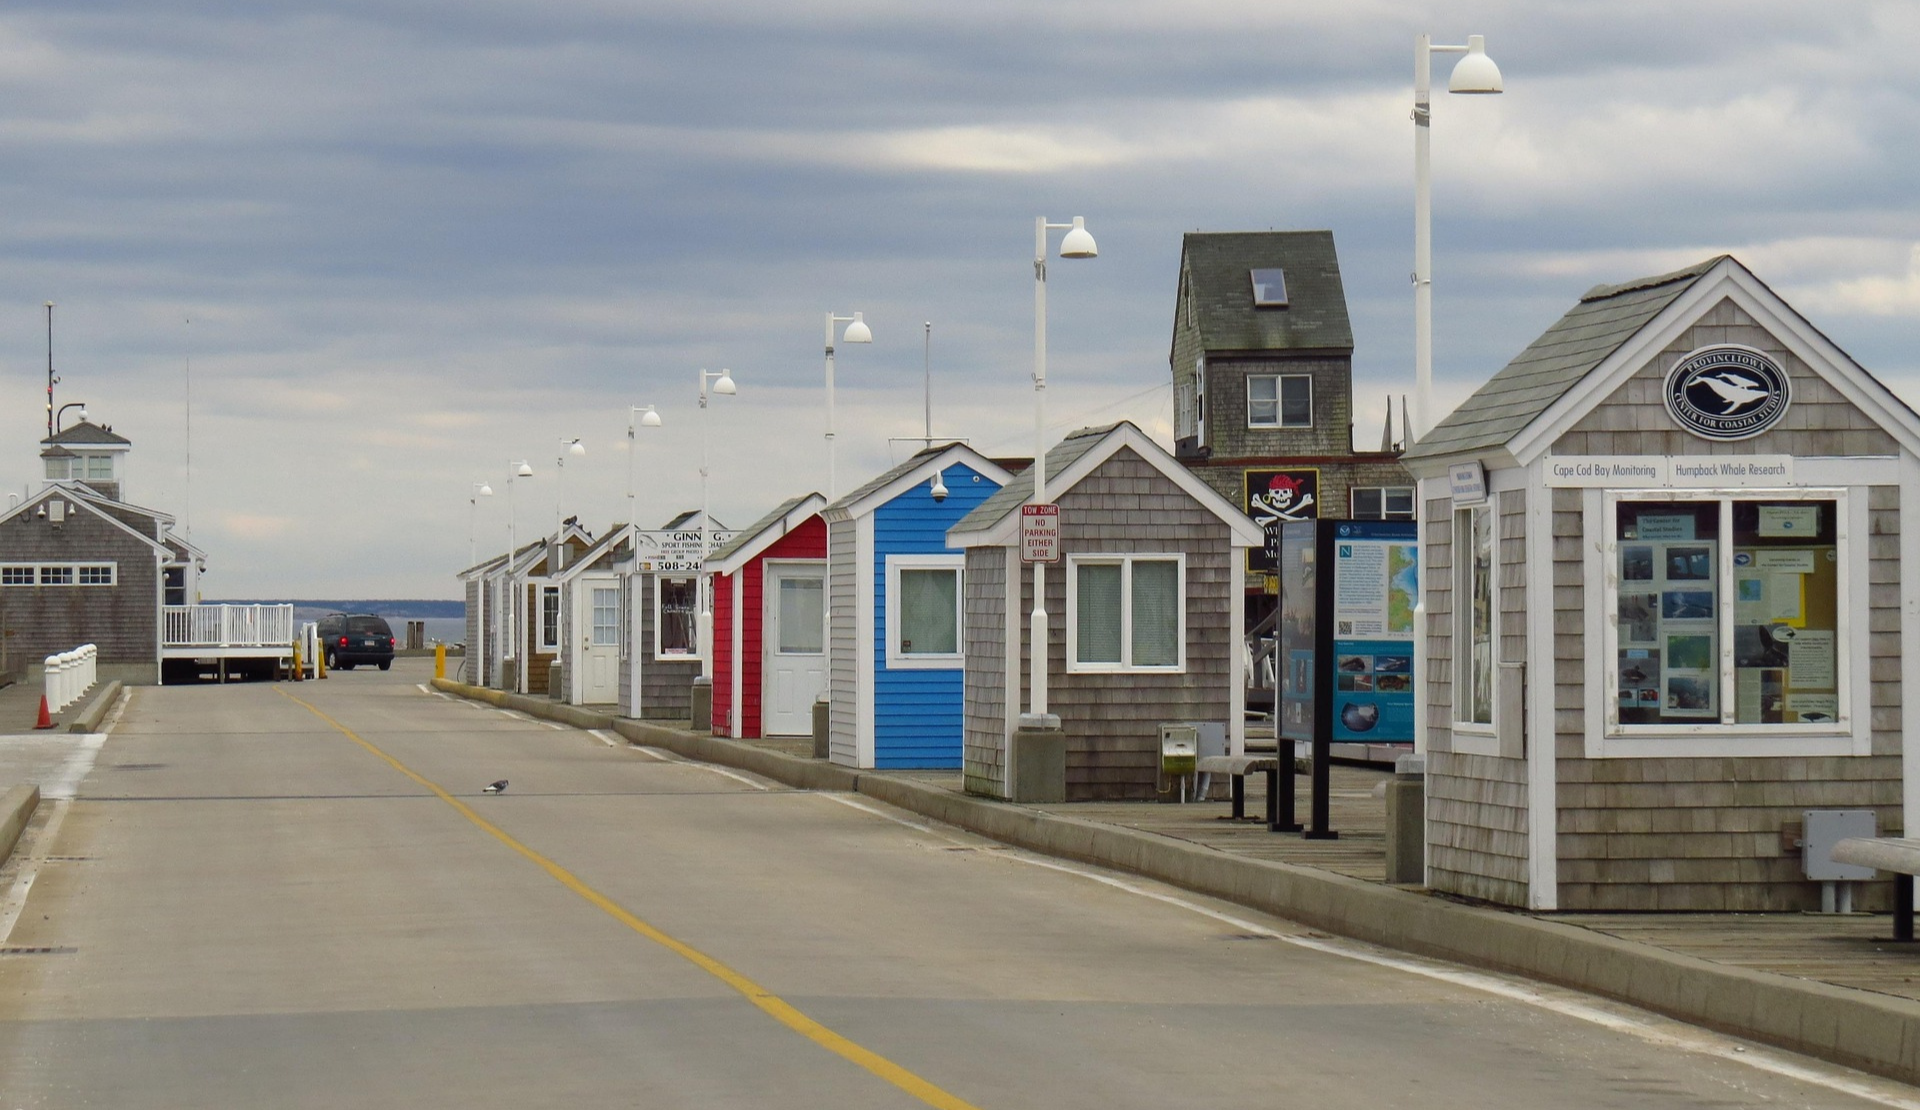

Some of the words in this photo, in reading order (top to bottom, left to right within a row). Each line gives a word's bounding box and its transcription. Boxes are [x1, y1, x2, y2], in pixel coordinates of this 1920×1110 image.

[1686, 353, 1767, 373] PROVINCETOWN
[1674, 392, 1700, 421] CENTER
[1699, 415, 1717, 428] FOR
[1719, 415, 1759, 429] COASTAL
[1758, 390, 1781, 419] STUDIES
[1553, 463, 1574, 478] Cape
[1576, 463, 1592, 476] Cod
[1594, 463, 1611, 478] Bay
[1612, 463, 1656, 478] Monitoring
[1675, 463, 1719, 478] Humpback
[1720, 463, 1746, 475] Whale
[1748, 463, 1786, 475] Research
[1024, 506, 1037, 514] TOW
[1041, 506, 1056, 514] ZONE
[673, 532, 702, 541] GINN
[1025, 529, 1056, 537] PARKING
[1028, 539, 1053, 547] EITHER
[1032, 549, 1049, 557] SIDE
[657, 561, 702, 571] 508-24
